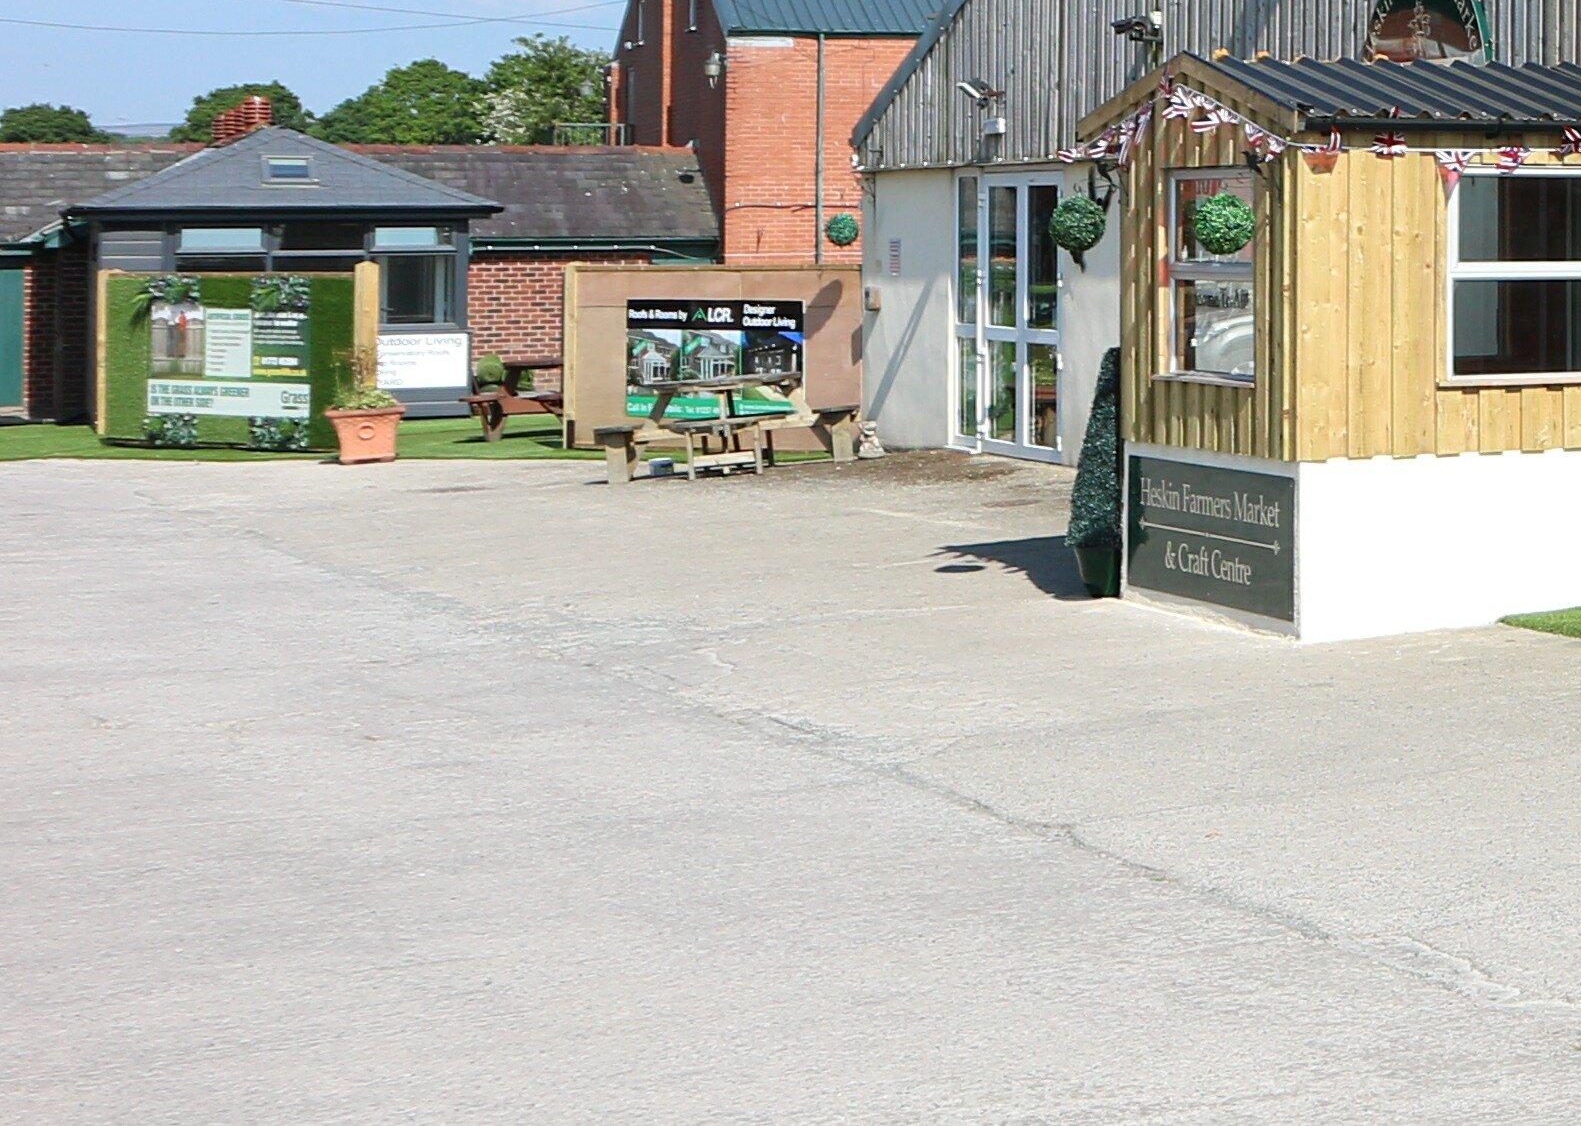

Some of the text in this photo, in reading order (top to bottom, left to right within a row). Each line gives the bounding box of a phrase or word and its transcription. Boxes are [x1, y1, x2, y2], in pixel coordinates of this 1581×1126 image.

[1140, 477, 1280, 528] Heskin Farmers Market
[1165, 540, 1251, 586] & Craft Centre
